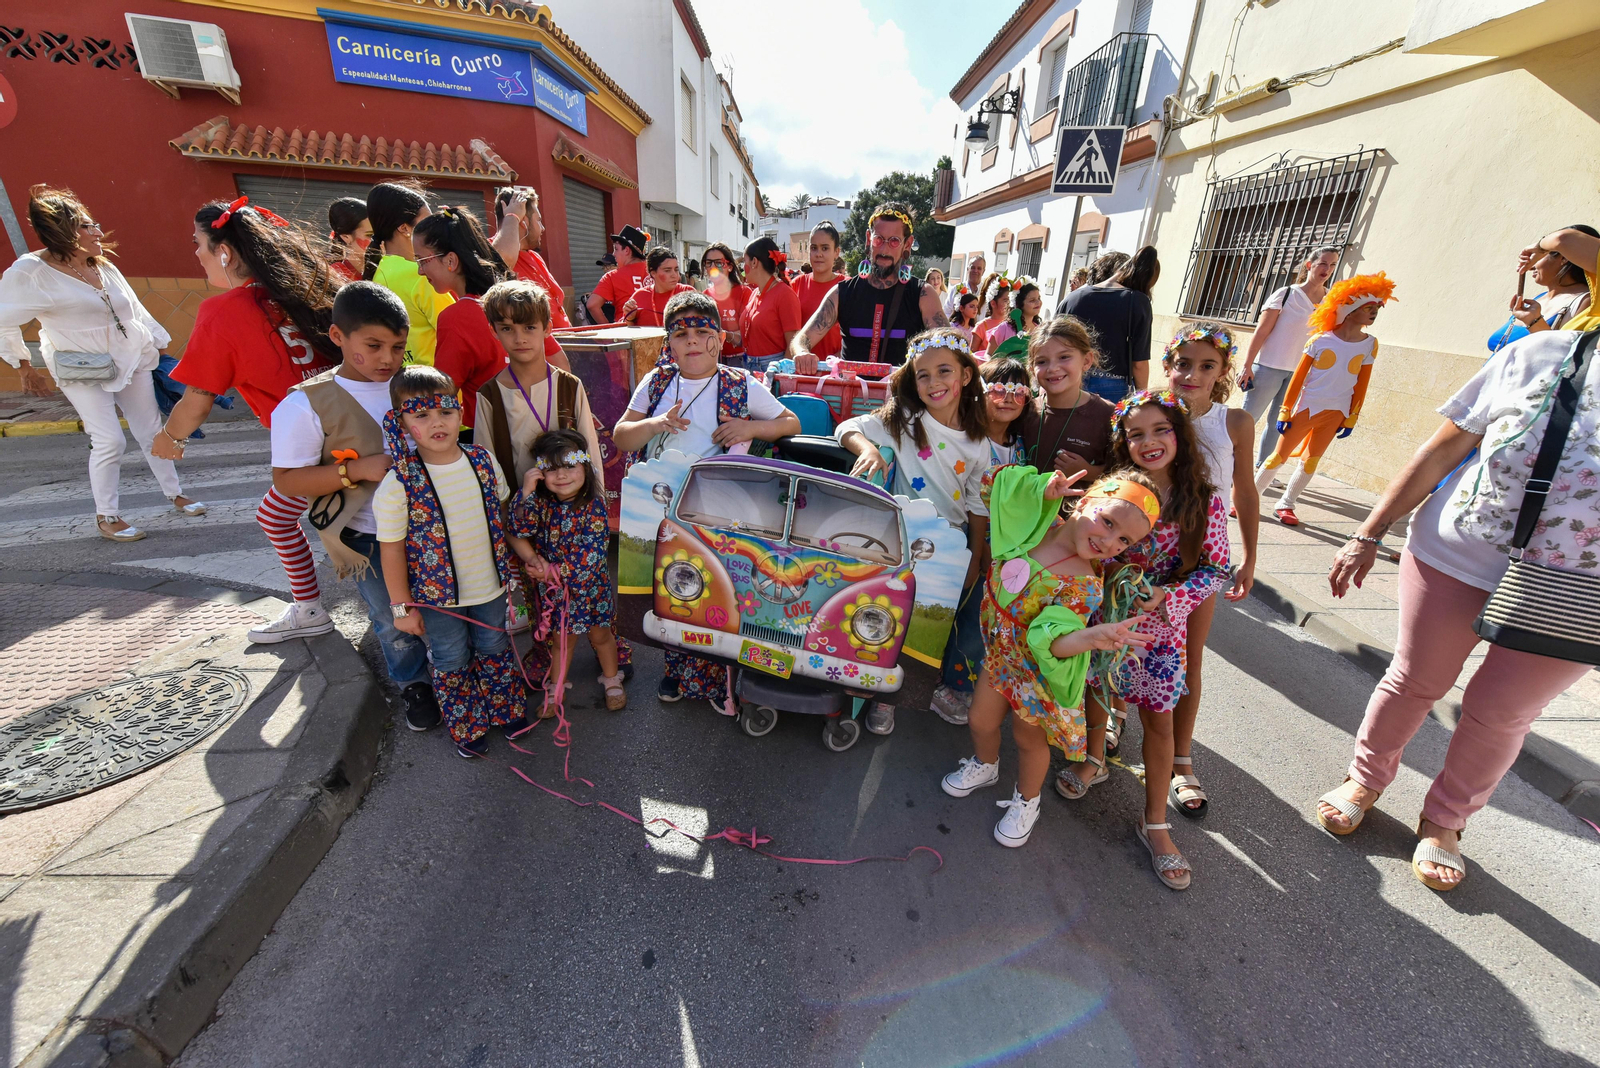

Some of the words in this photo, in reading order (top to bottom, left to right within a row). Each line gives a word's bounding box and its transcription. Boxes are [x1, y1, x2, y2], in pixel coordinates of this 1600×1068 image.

[337, 36, 441, 67] Carnicería
[451, 53, 502, 76] Curro
[534, 67, 564, 100] Carnicería
[565, 93, 579, 109] Curro
[783, 600, 813, 619] LOVE
[789, 622, 819, 634] WAR
[794, 616, 812, 625] NOT
[683, 631, 712, 645] LOVE
[747, 646, 786, 673] Peace
